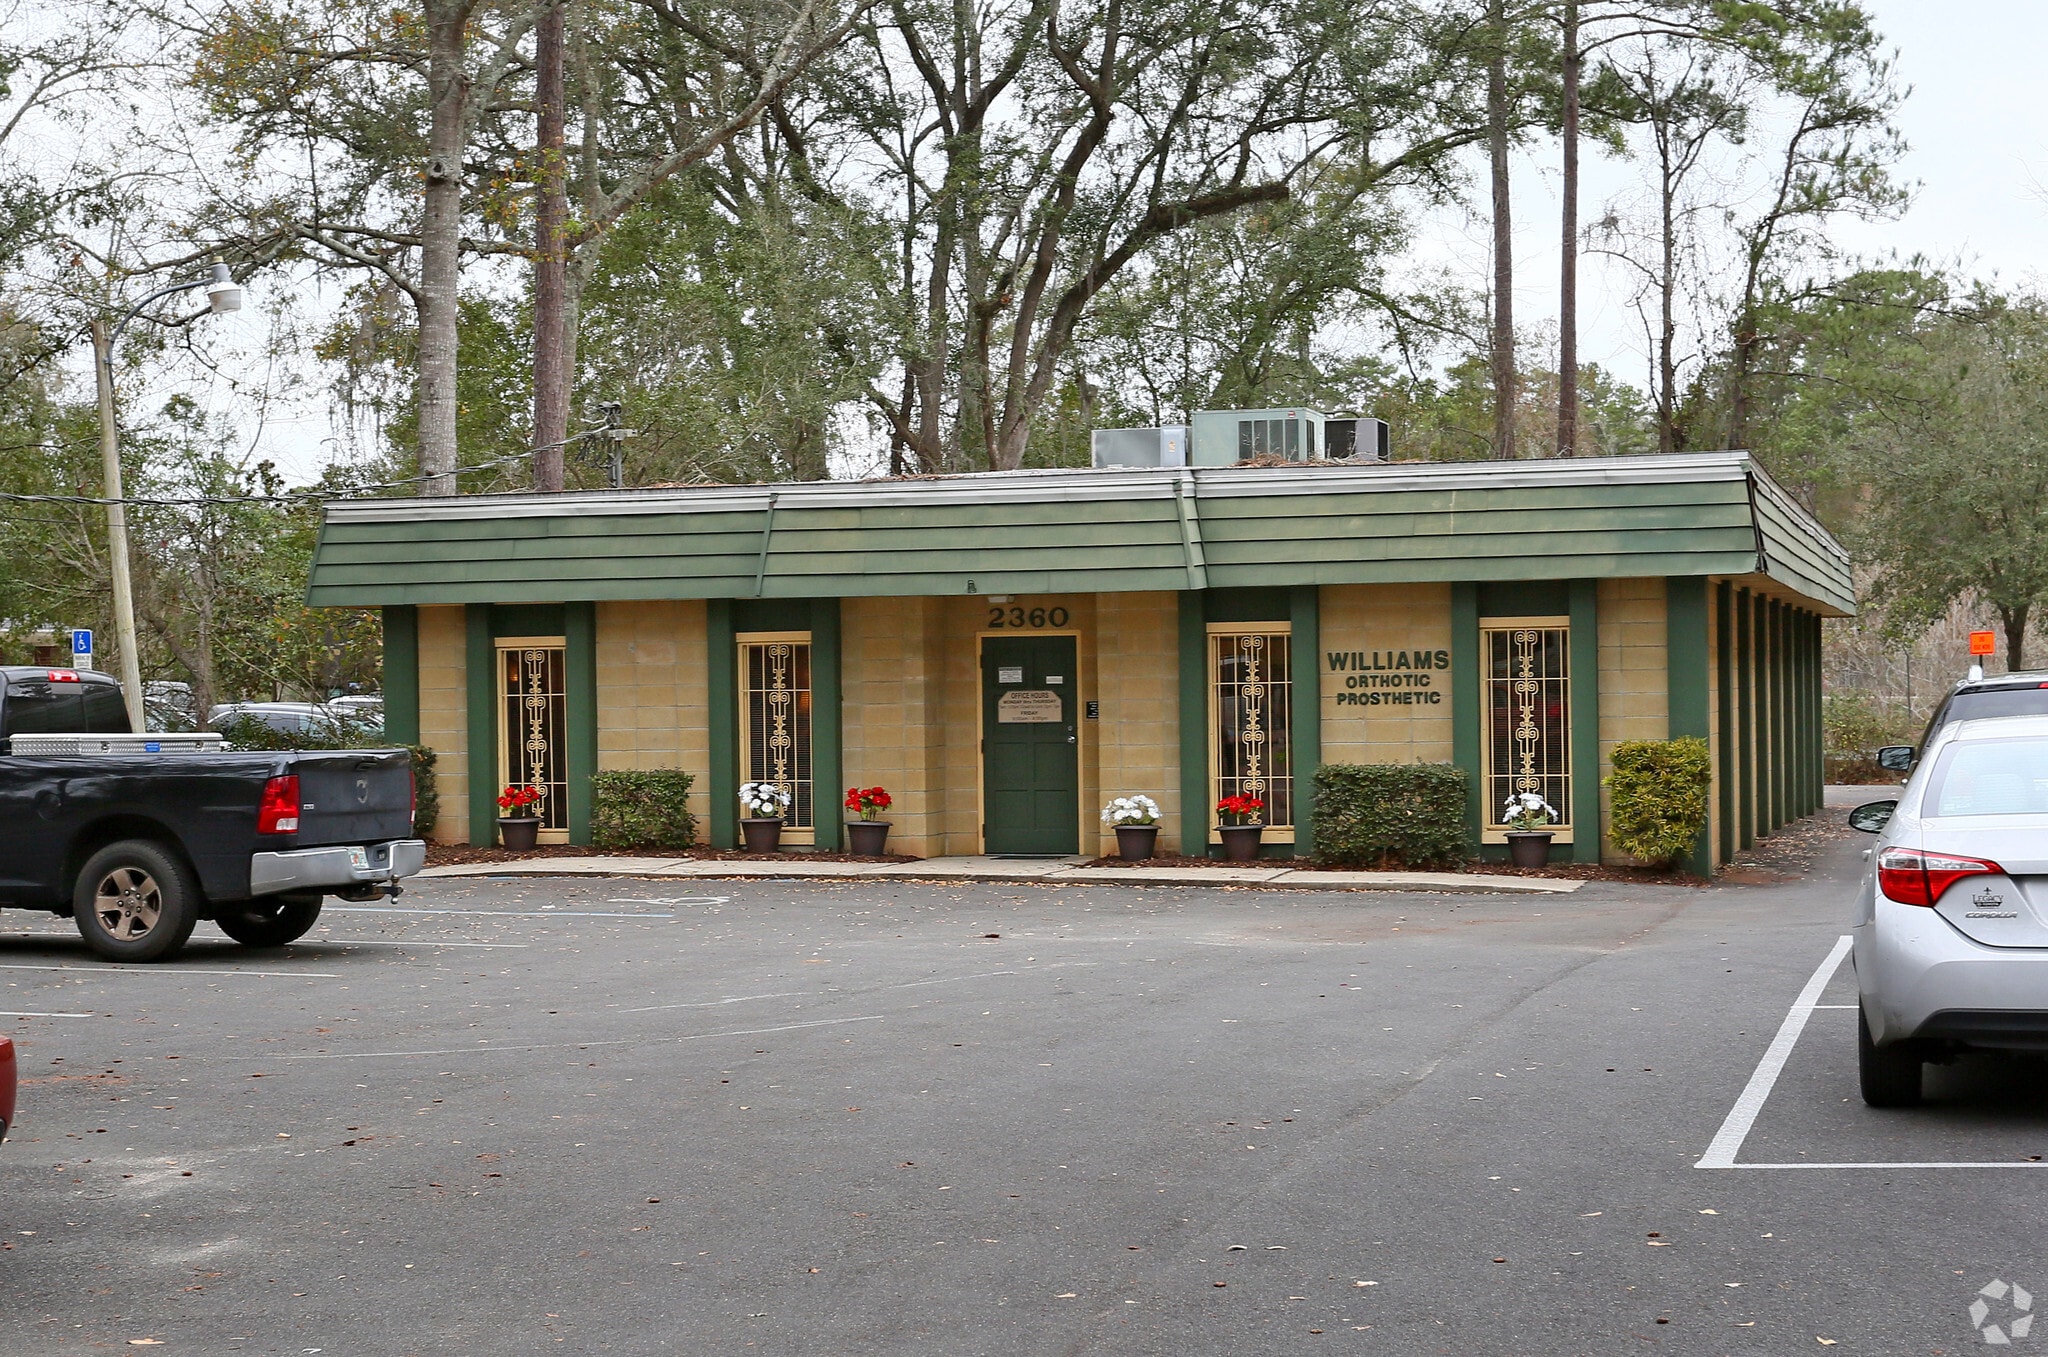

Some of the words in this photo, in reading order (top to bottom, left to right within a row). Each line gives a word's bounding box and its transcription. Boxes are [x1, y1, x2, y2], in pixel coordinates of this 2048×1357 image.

[988, 607, 1069, 628] 2360
[1327, 650, 1449, 671] WILLIAMS
[1345, 673, 1431, 689] ORTHOTIC
[1337, 691, 1441, 705] PROSTHETIC
[1965, 911, 2018, 919] COROLLA
